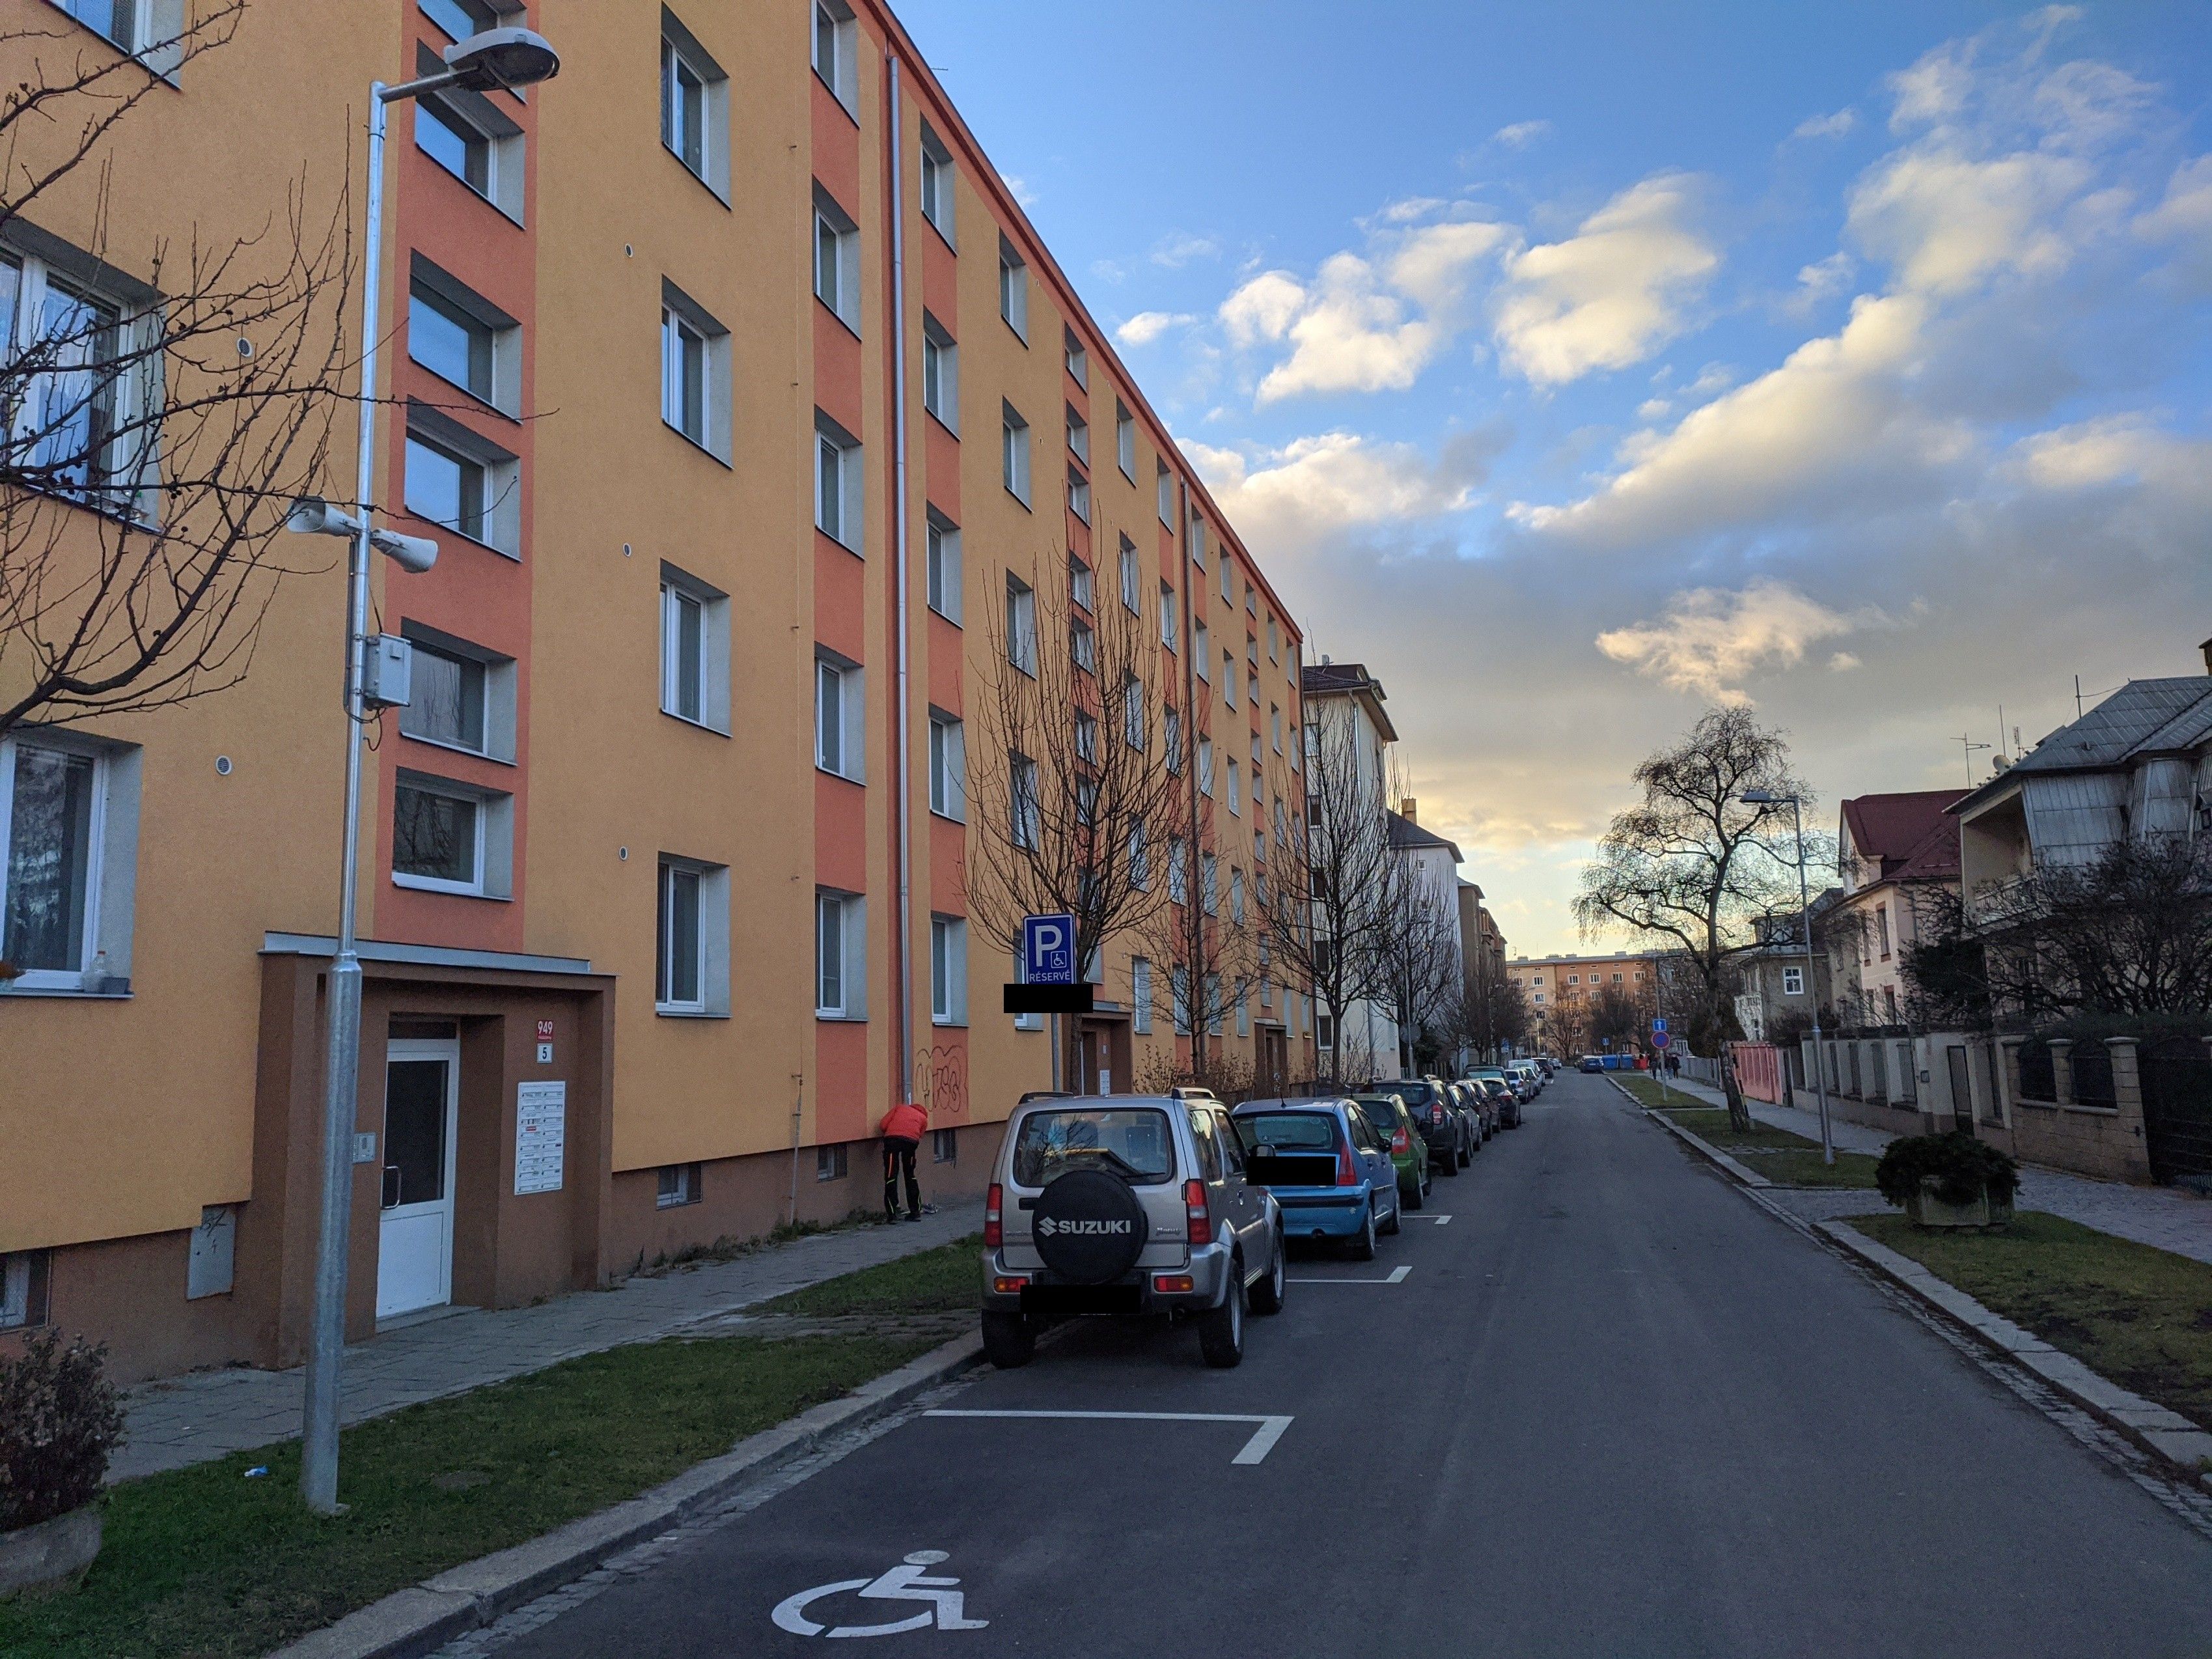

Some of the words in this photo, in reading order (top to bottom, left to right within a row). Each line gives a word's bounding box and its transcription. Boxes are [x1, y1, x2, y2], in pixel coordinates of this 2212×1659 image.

[1035, 925, 1062, 967] P
[1029, 969, 1070, 982] RÉSERVÉ
[538, 1021, 553, 1034] 949
[542, 1047, 547, 1059] 5
[1058, 1220, 1131, 1234] SUZUKI
